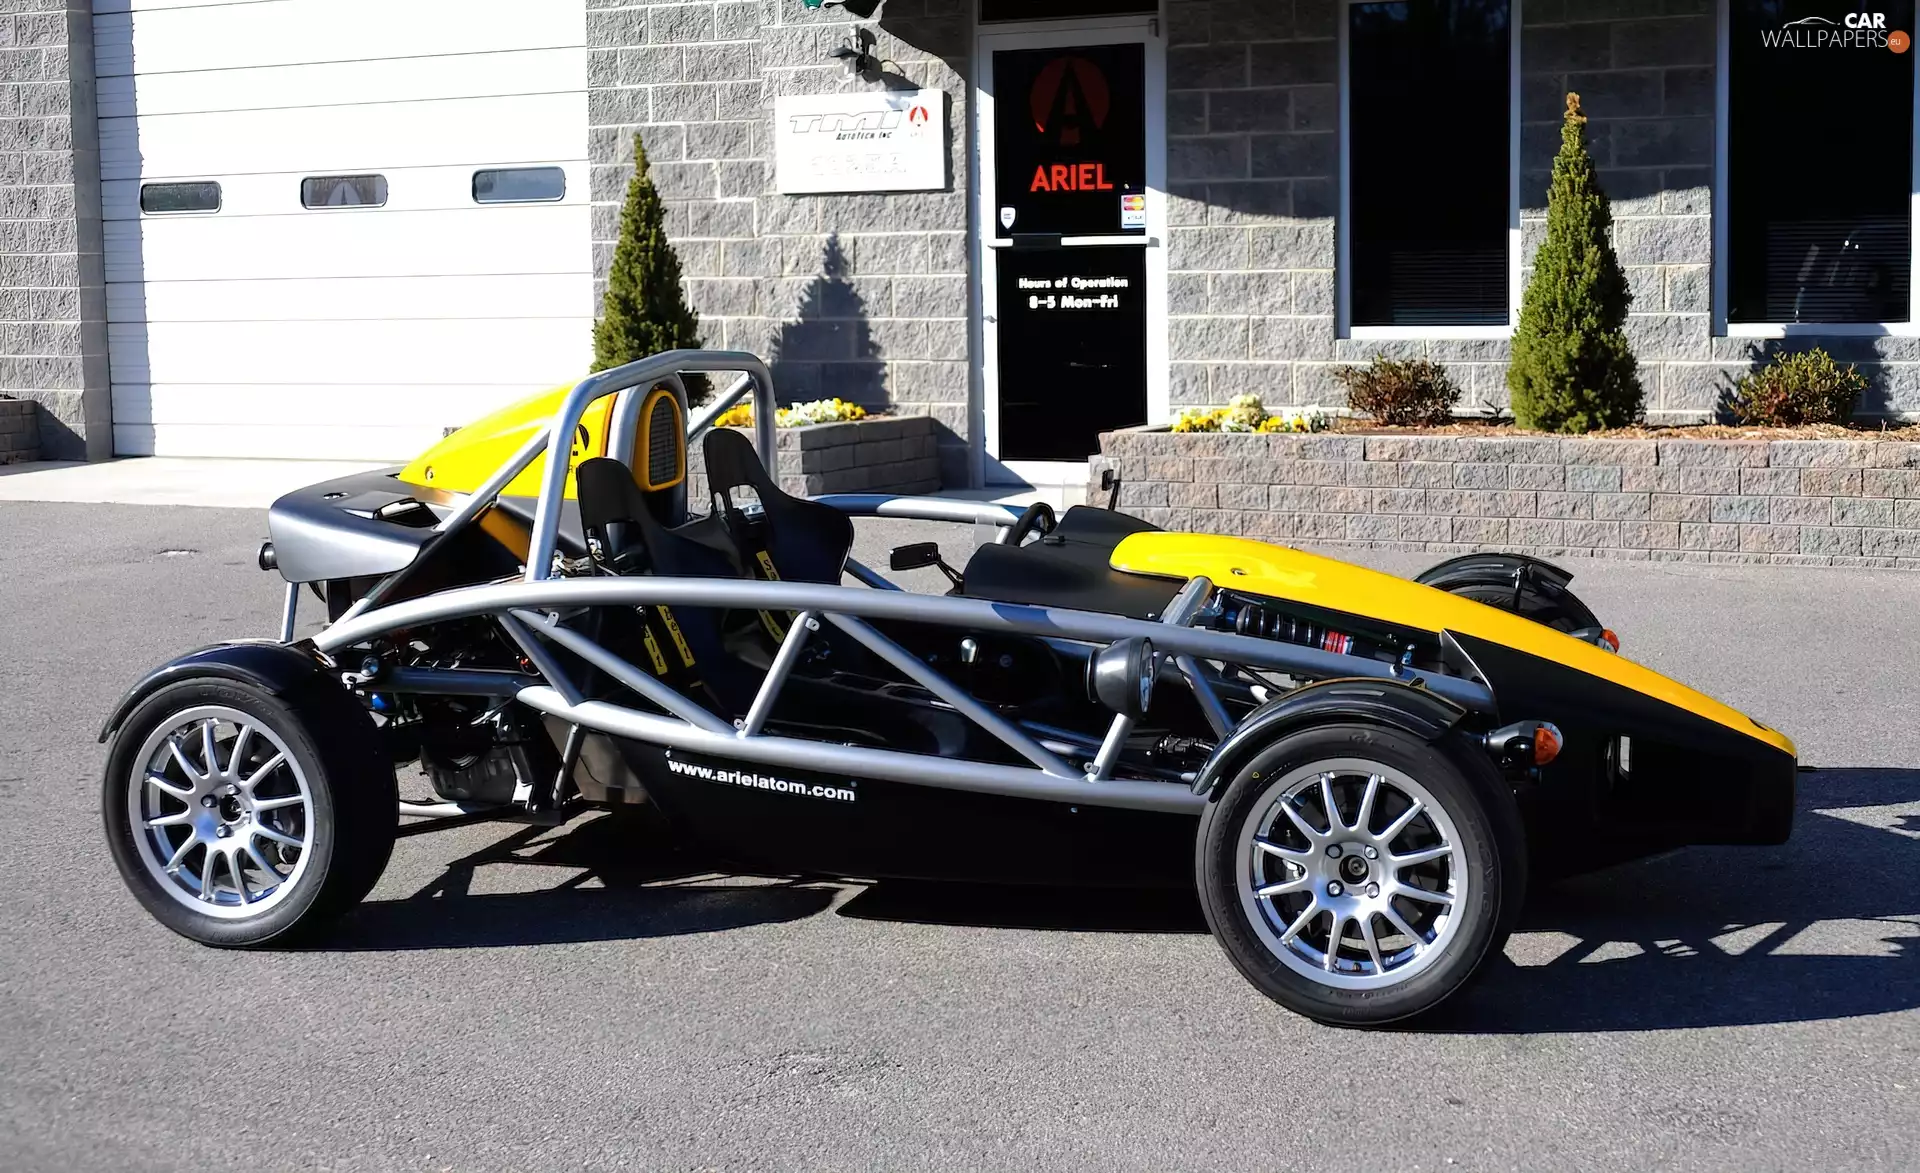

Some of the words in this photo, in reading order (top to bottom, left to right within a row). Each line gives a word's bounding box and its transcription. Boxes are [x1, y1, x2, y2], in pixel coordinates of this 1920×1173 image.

[789, 110, 903, 134] TMI
[1030, 163, 1114, 192] ARIEL
[1018, 277, 1052, 289] Hours
[1055, 276, 1068, 288] of
[1071, 277, 1129, 290] Operation
[667, 760, 856, 801] www.arielatom.com
